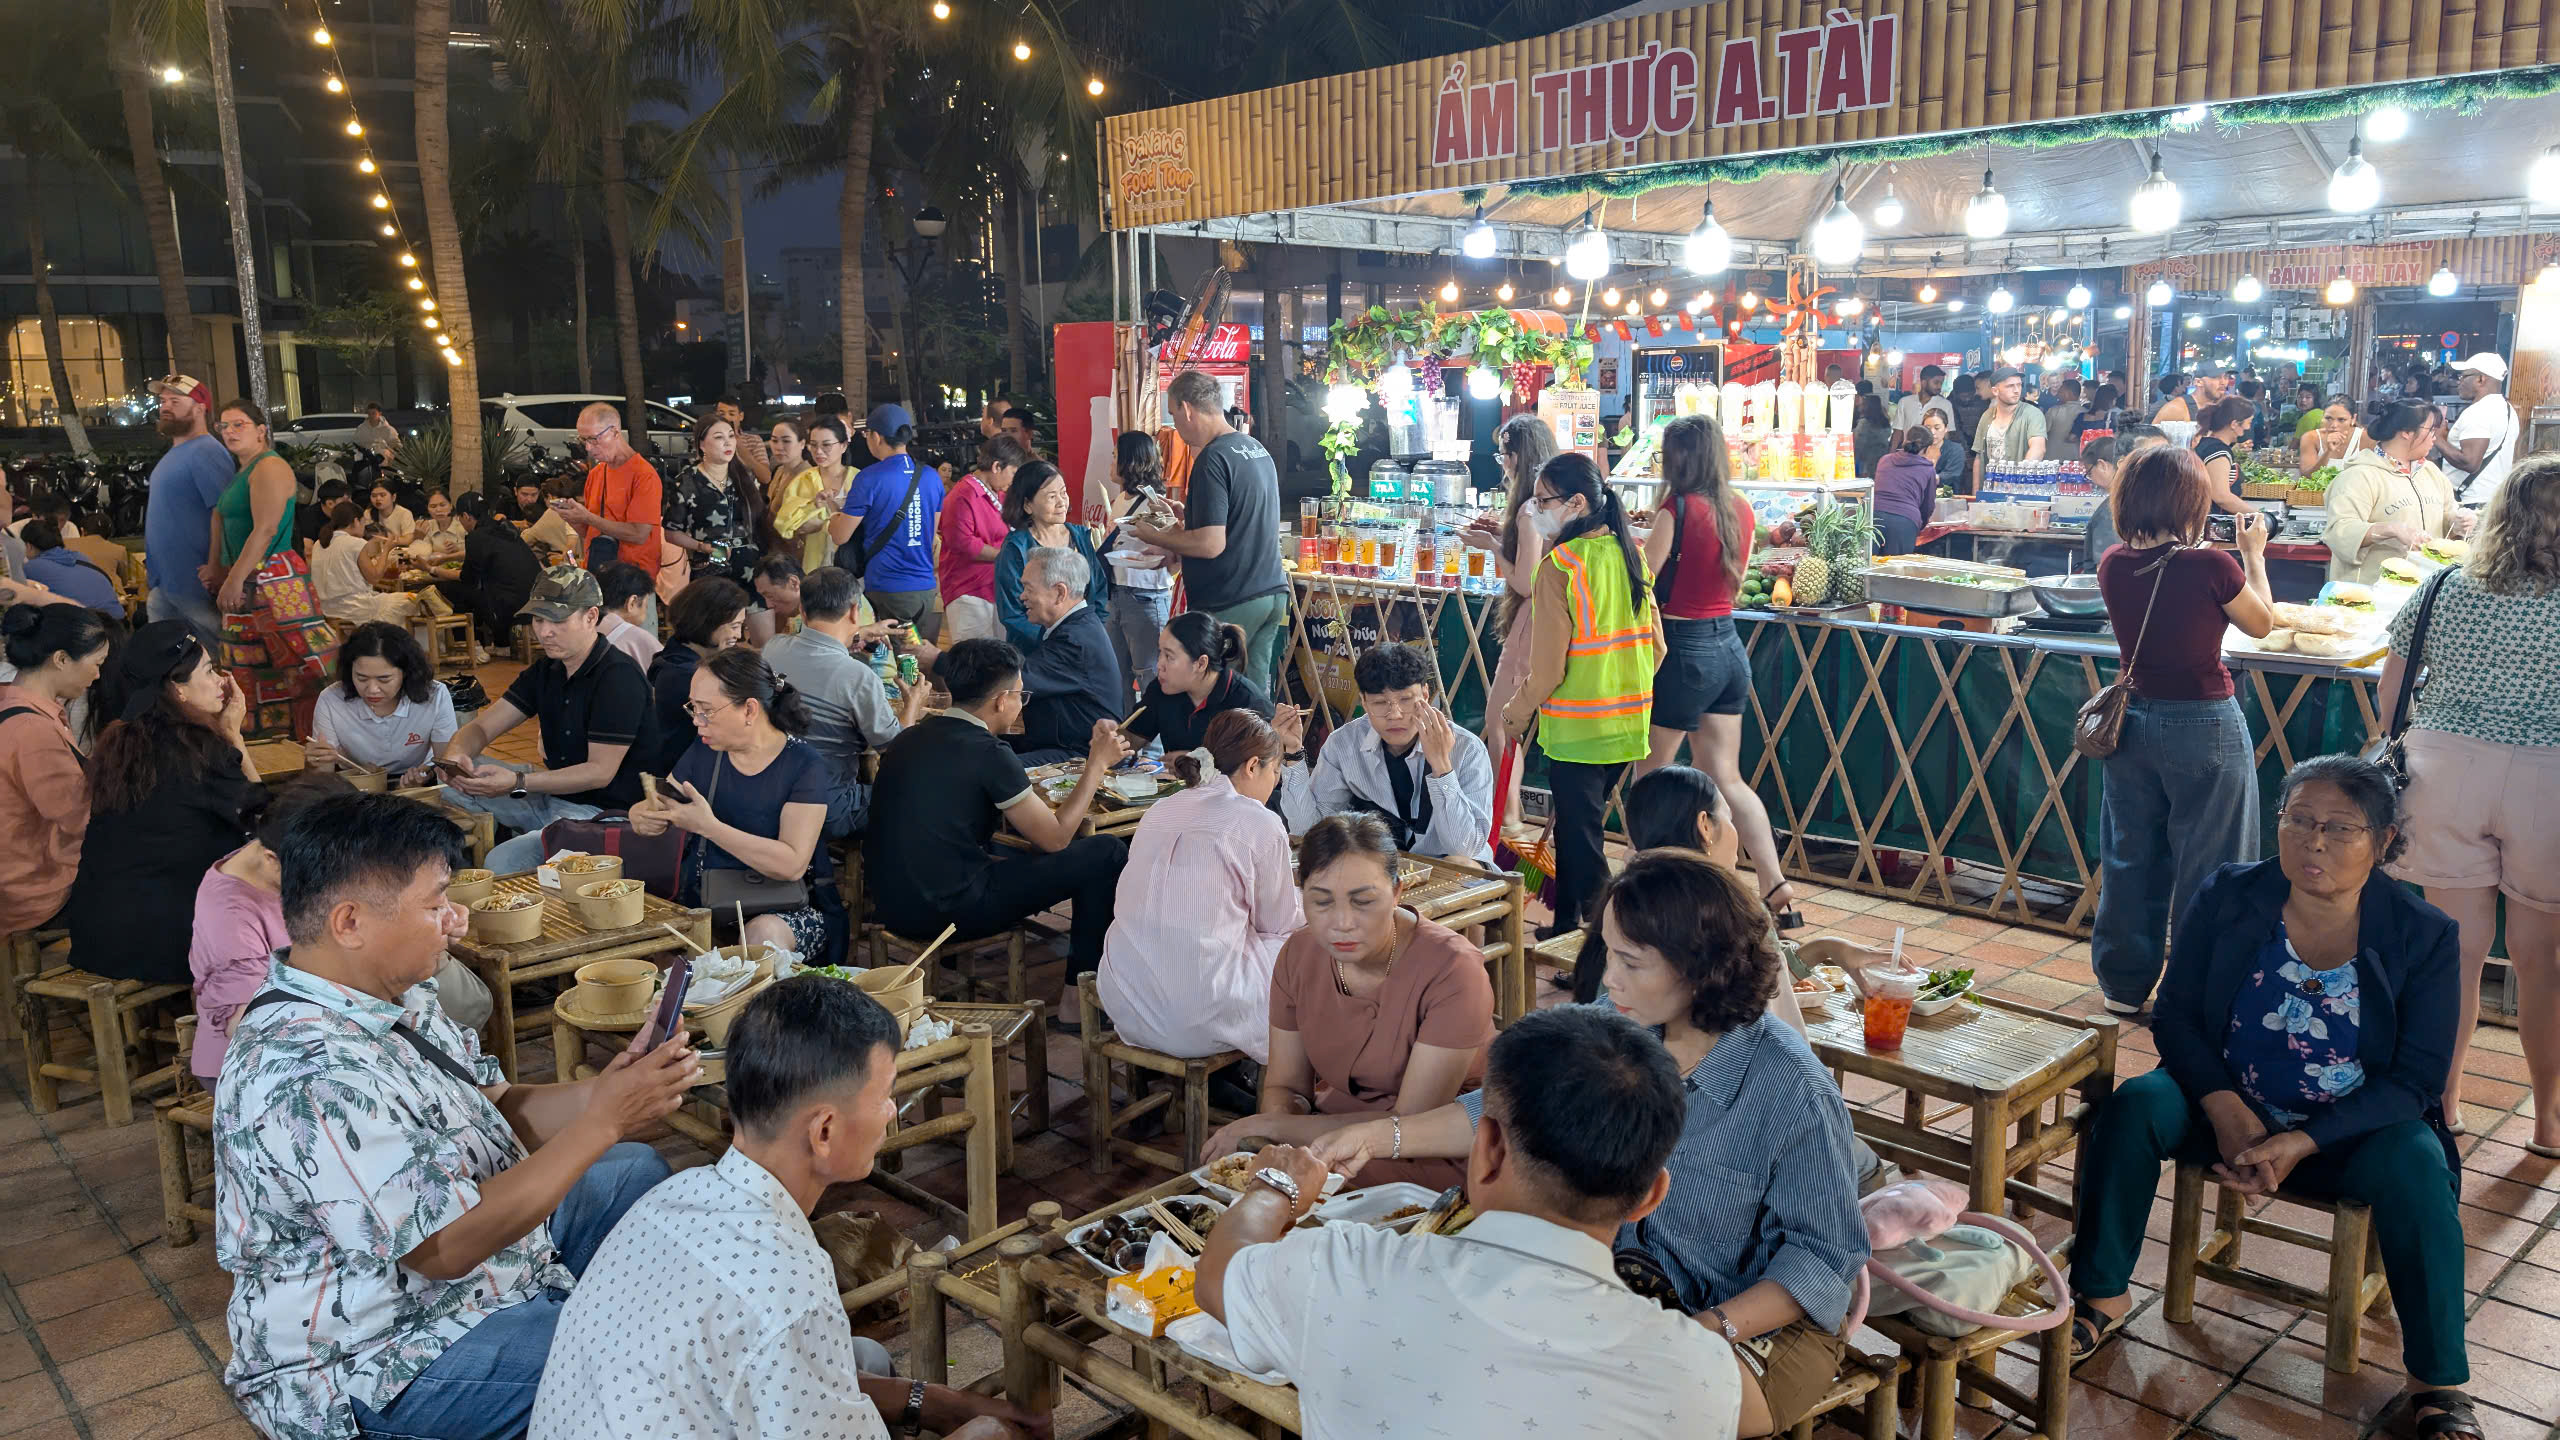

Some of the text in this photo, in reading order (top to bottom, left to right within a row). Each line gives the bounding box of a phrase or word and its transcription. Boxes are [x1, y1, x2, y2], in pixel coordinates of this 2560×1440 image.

[1432, 7, 1898, 167] ẨM THỰC A.TÀI
[1121, 160, 1194, 200] Food Tour
[2268, 264, 2321, 285] BÁNH
[913, 488, 922, 538] TOMORR
[1520, 790, 1544, 805] Dasa
